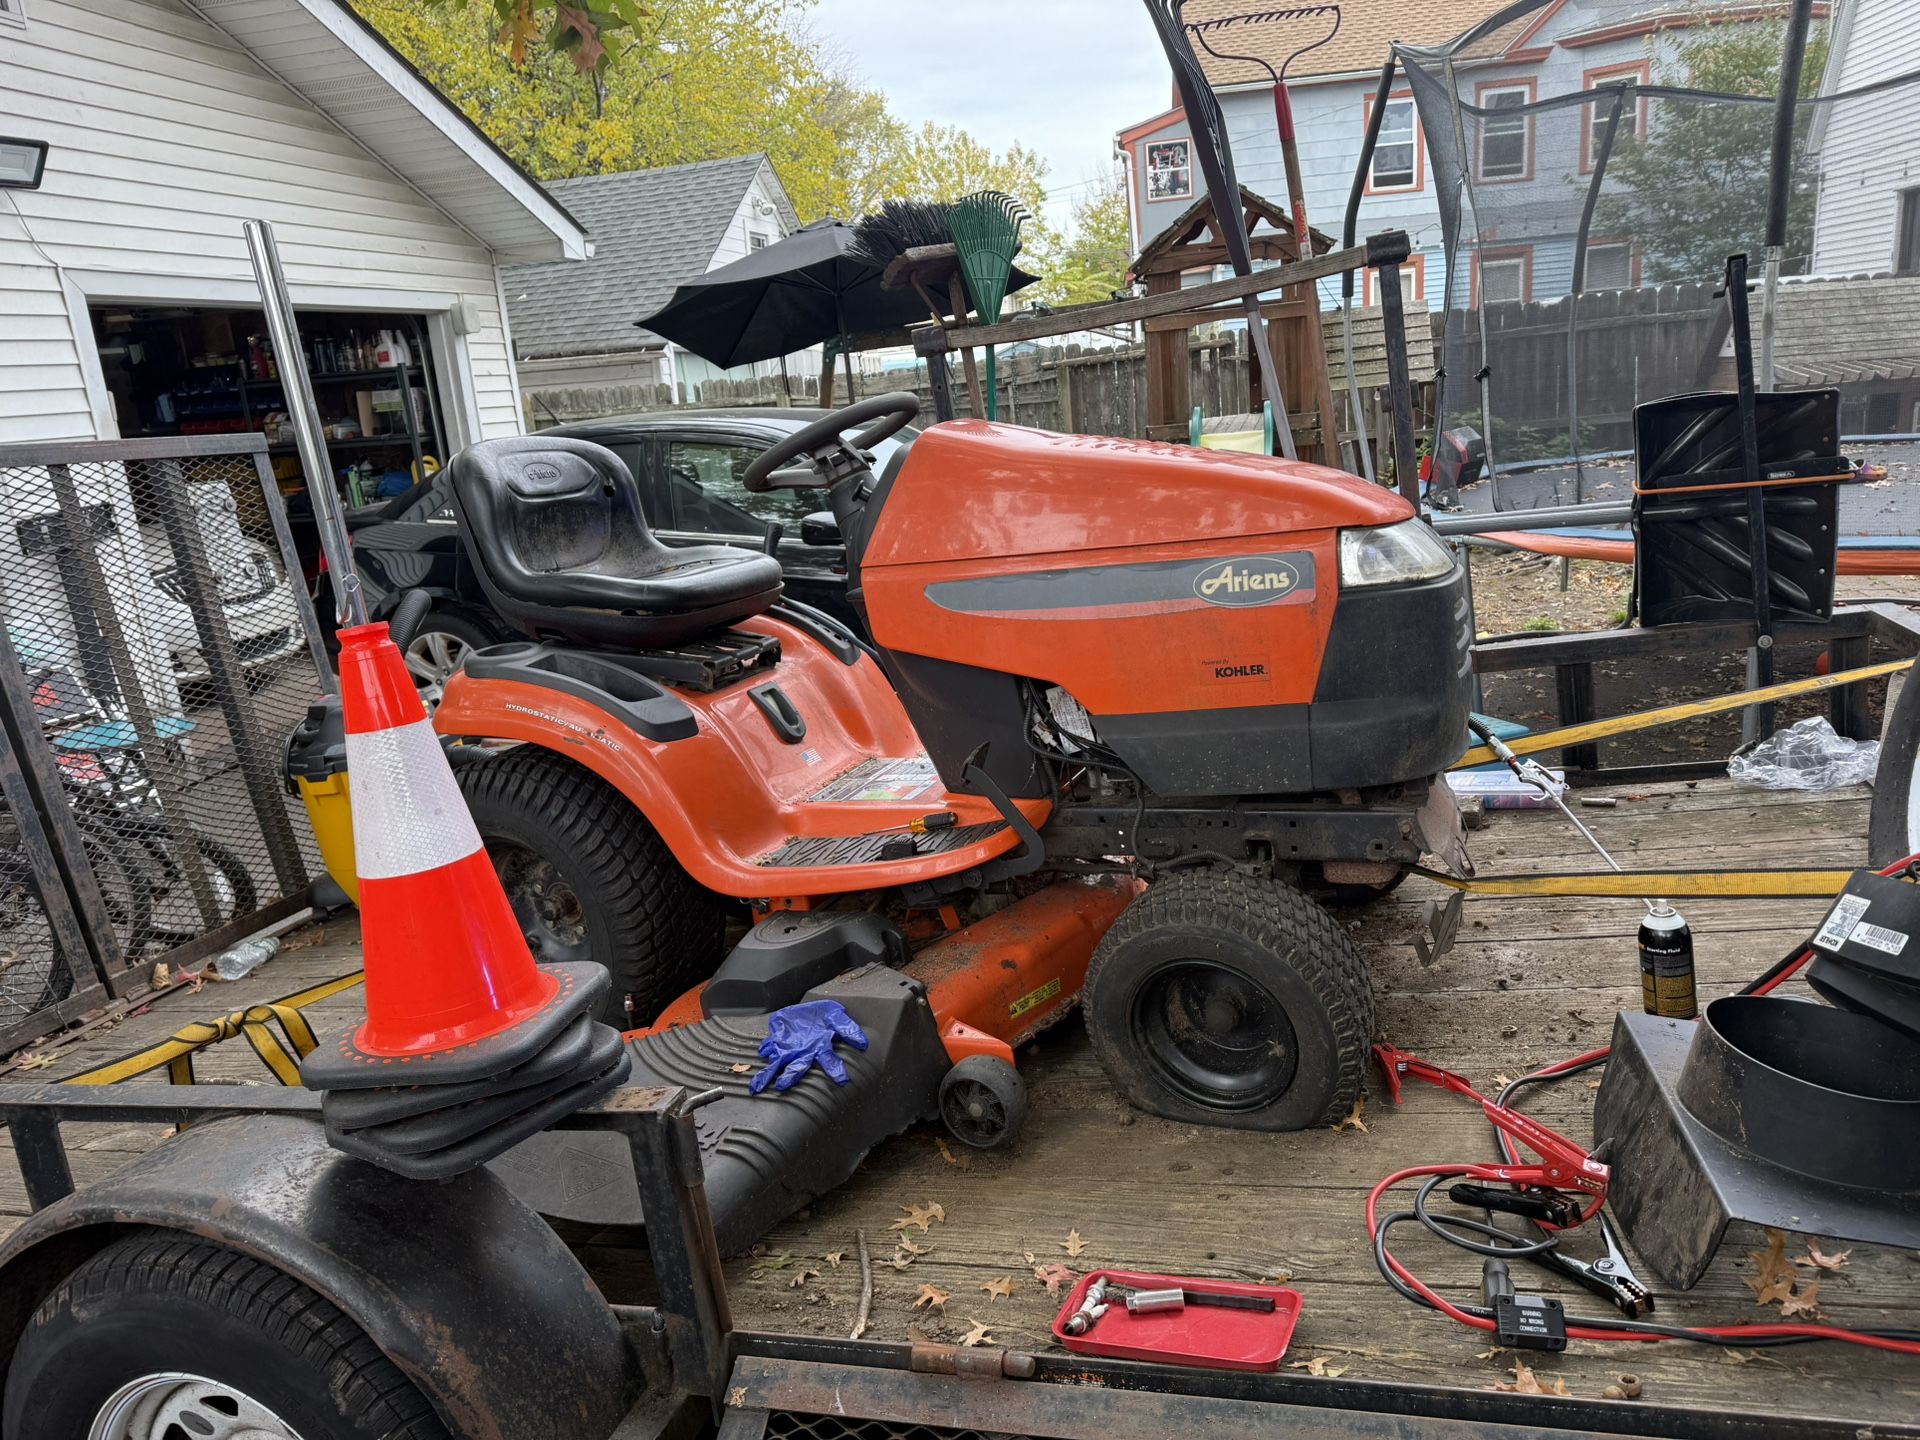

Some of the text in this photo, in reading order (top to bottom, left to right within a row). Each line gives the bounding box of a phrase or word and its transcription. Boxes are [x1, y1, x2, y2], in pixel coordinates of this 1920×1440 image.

[1201, 566, 1290, 595] Ariens
[505, 702, 622, 752] HYDROSTATIC/AUATIC
[1646, 946, 1667, 955] Starting
[1519, 1325, 1548, 1333] CONNECTION
